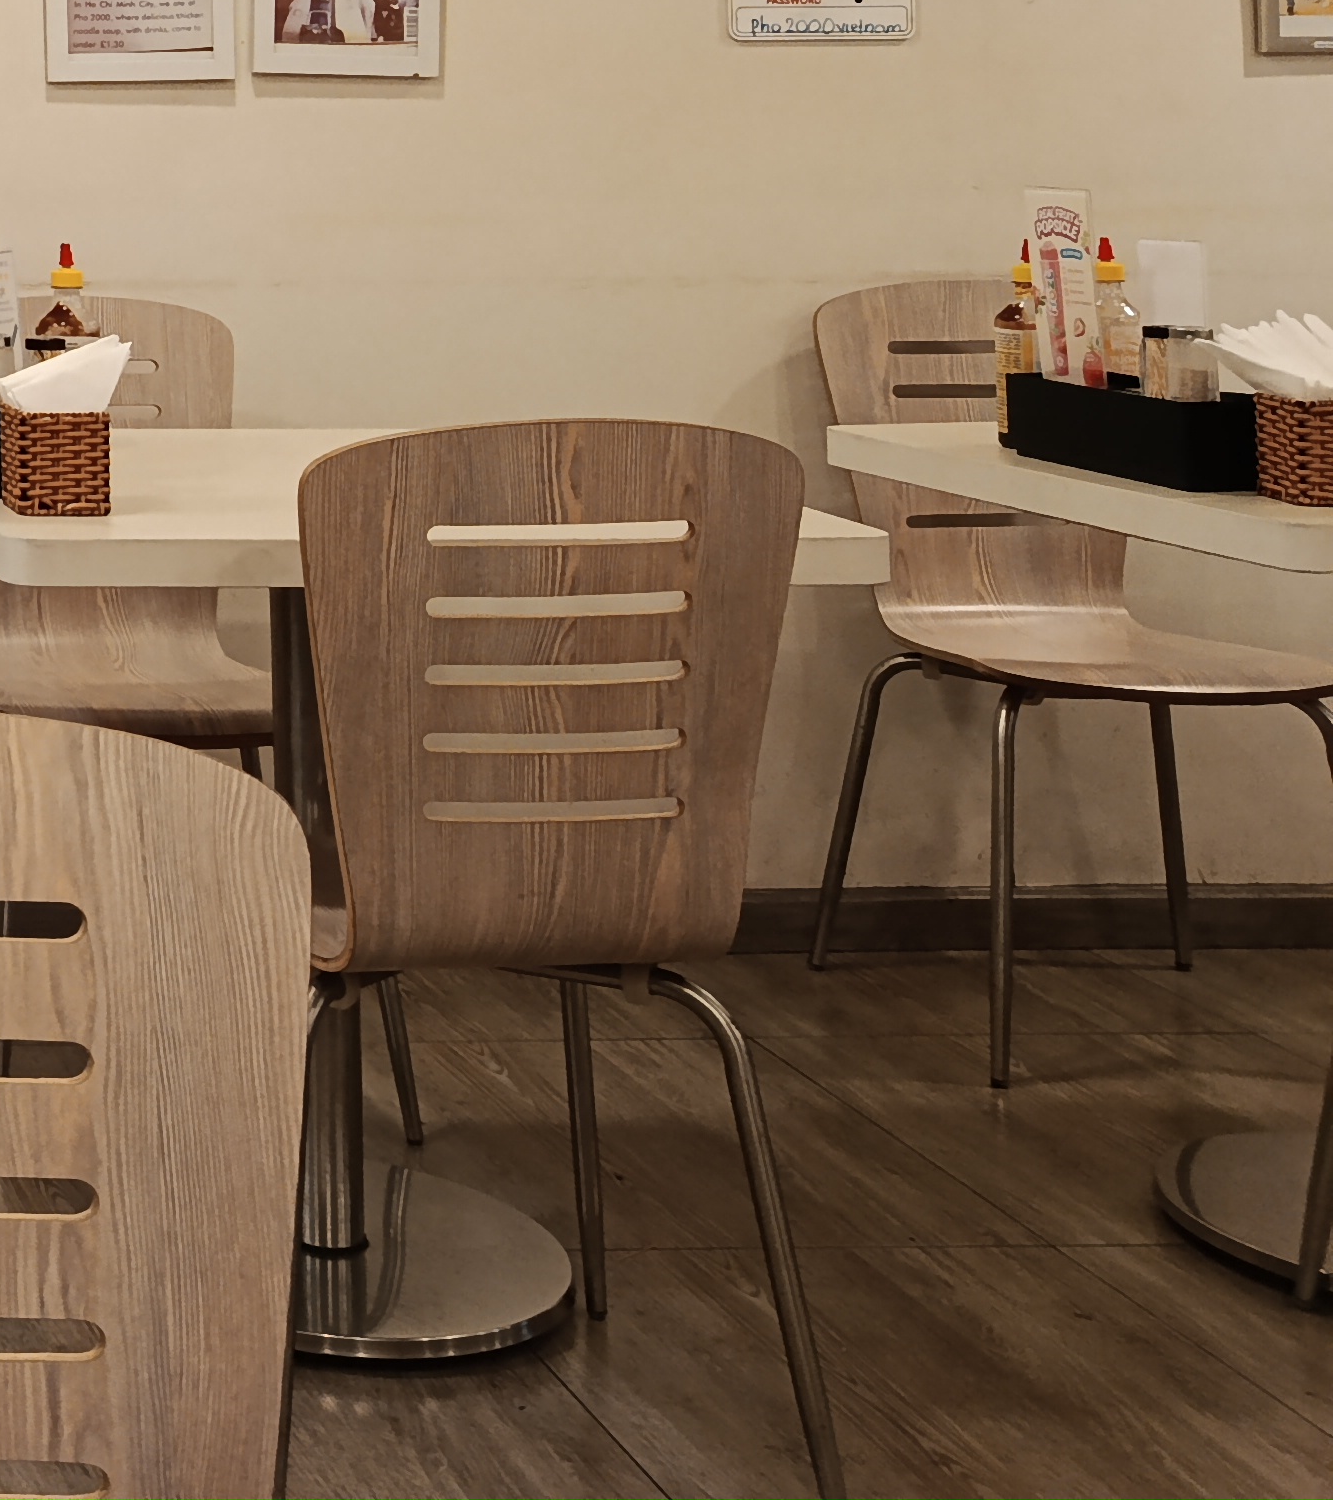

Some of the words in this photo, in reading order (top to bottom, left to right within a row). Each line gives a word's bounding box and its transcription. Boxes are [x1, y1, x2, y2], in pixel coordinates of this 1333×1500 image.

[73, 27, 99, 35] noodle
[1038, 207, 1053, 219] REAL
[1054, 207, 1075, 221] FRUIT
[1035, 220, 1079, 241] POPSICLE
